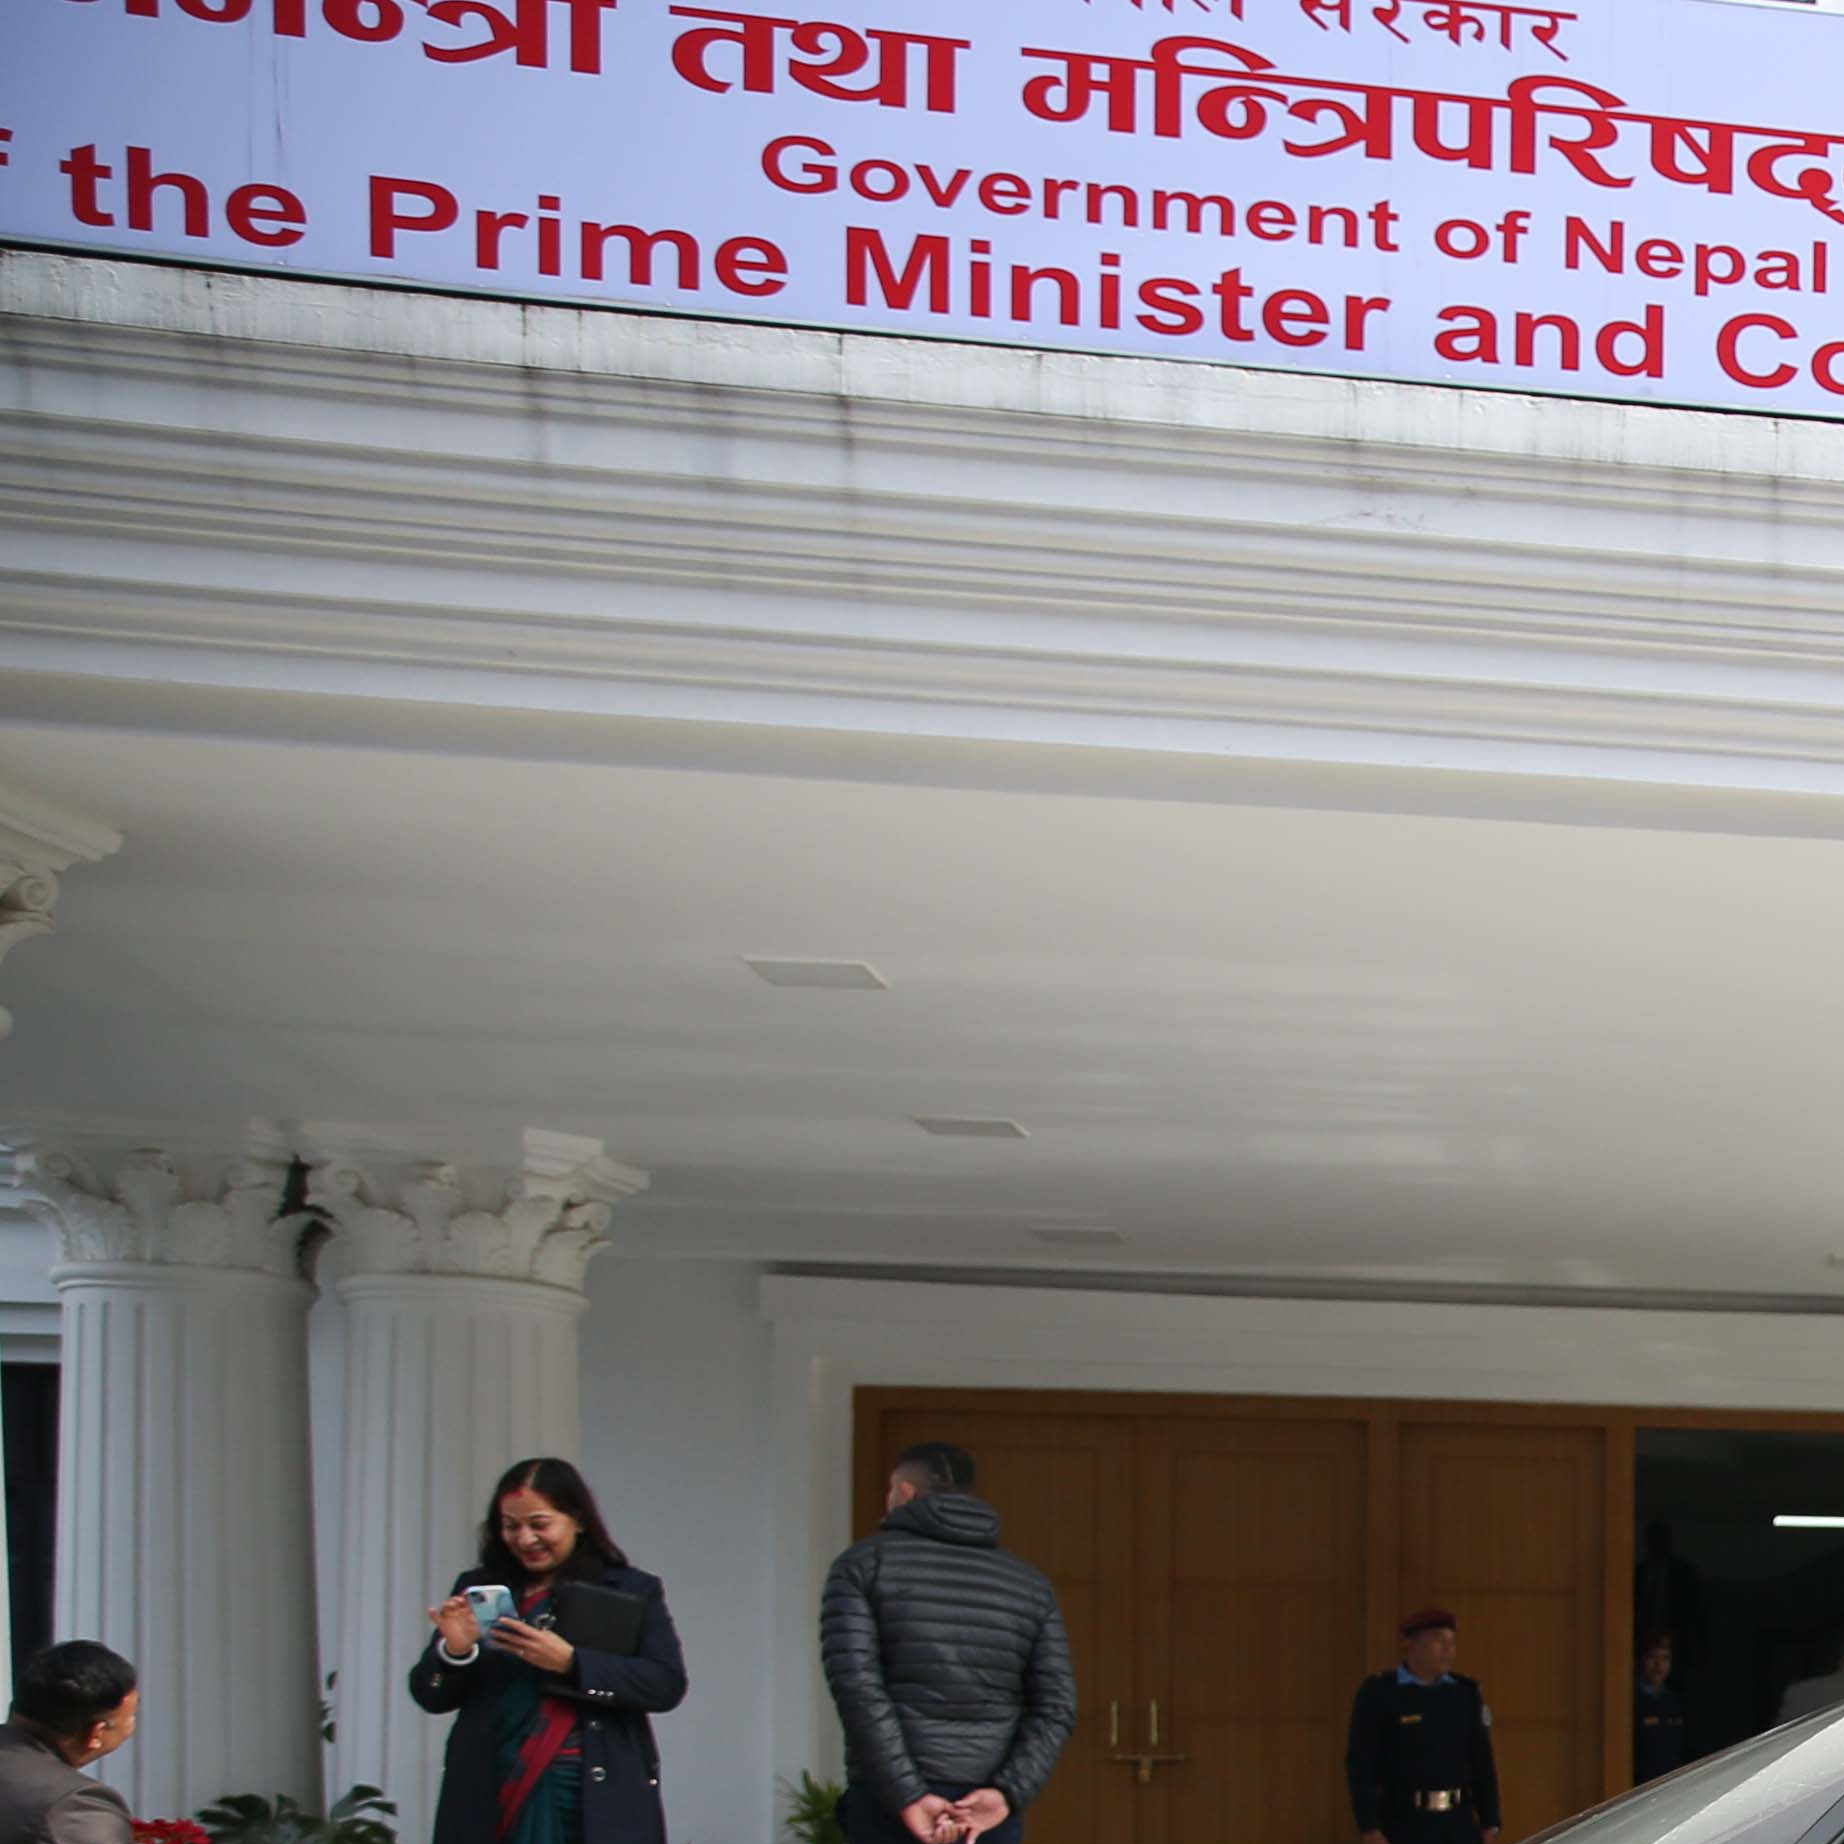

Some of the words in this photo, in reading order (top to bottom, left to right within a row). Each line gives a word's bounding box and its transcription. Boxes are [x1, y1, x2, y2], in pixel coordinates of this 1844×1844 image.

[670, 5, 972, 114] तथा
[1299, 0, 1579, 61] सरकार
[59, 145, 306, 248] the
[370, 175, 789, 297] Prime
[846, 226, 1392, 352] Minister
[1434, 304, 1665, 379] and
[762, 135, 1400, 253] Government
[1434, 209, 1532, 264] of
[1565, 215, 1828, 297] Nepal
